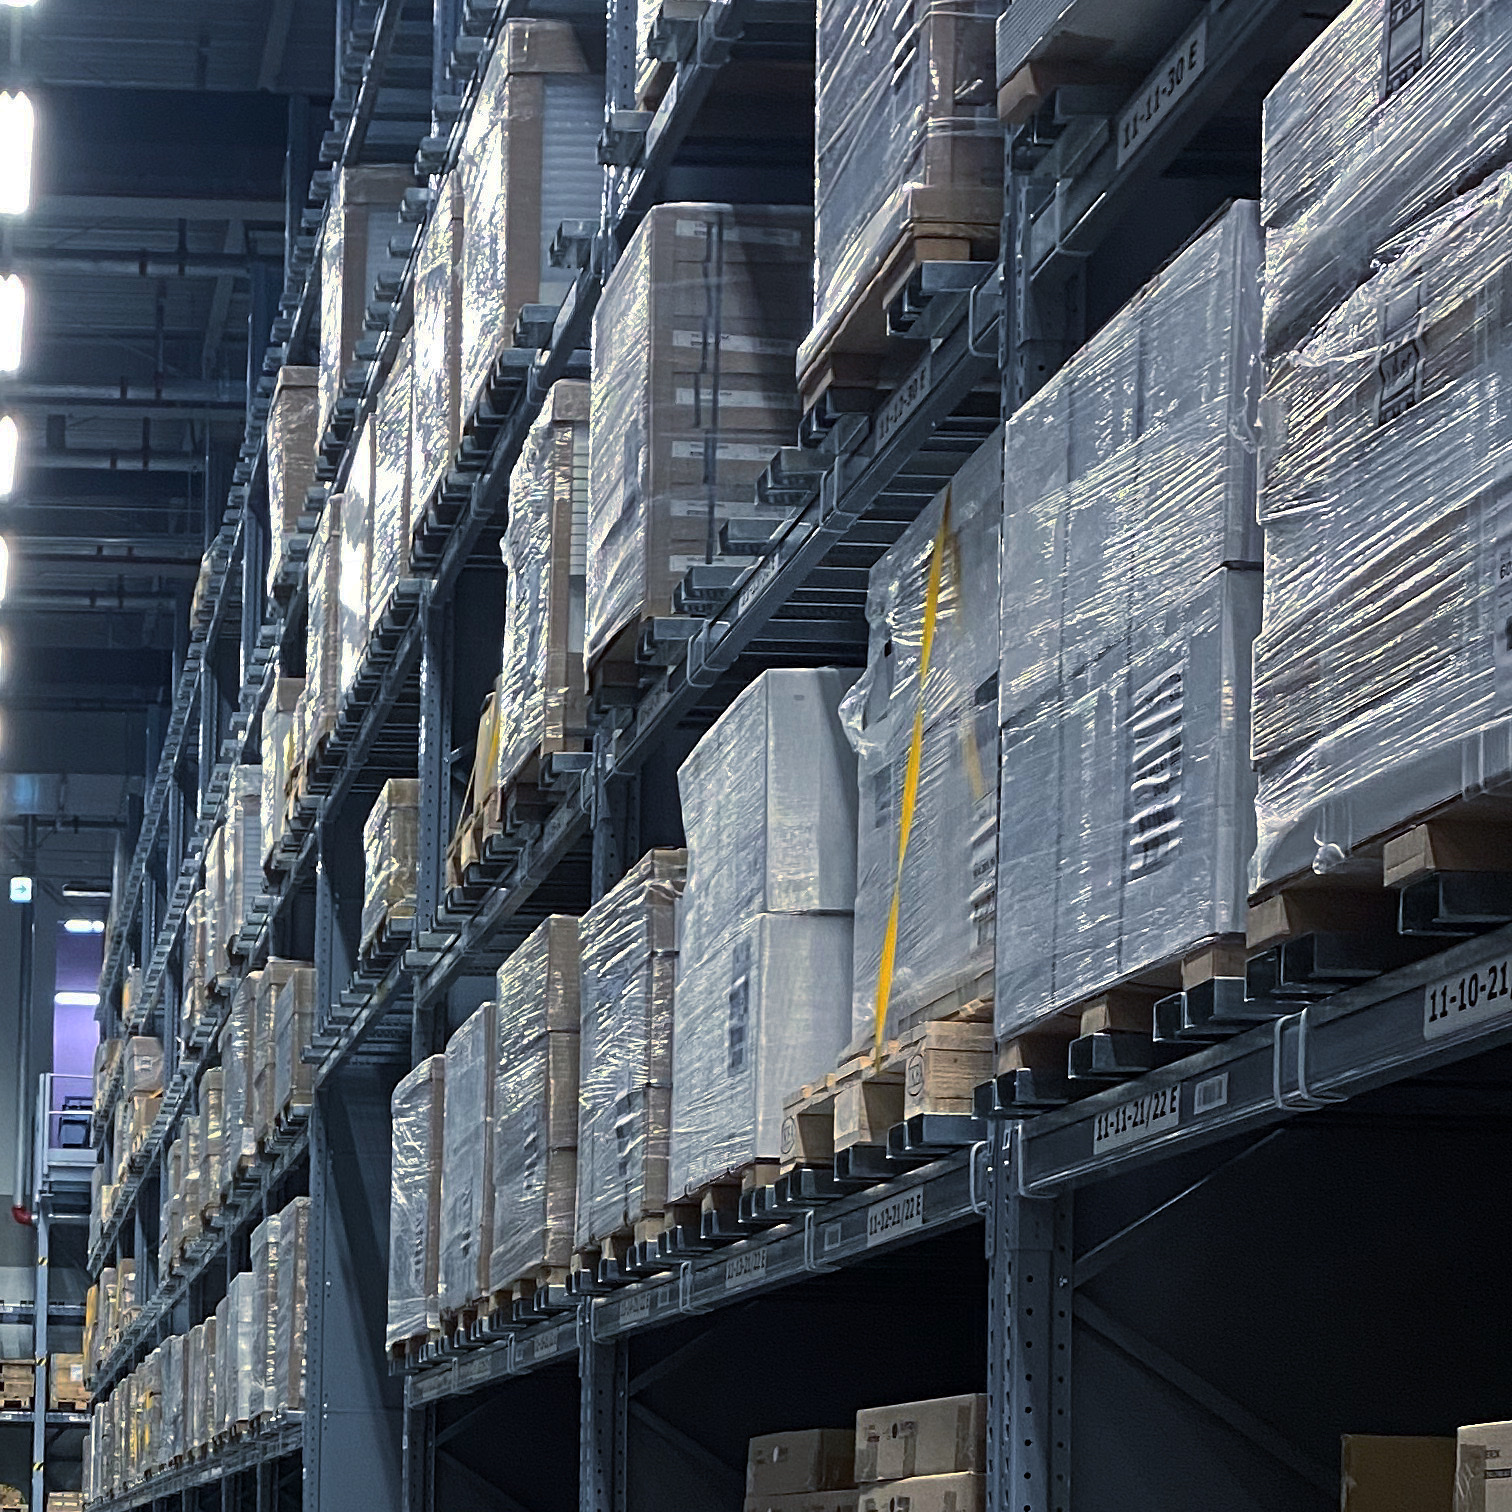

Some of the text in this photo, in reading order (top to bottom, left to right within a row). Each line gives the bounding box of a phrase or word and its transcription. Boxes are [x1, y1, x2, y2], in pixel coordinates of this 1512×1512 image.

[1124, 40, 1198, 149] 11-11-30 E
[1428, 960, 1512, 1023] 11-10-21
[1096, 1085, 1178, 1142] 11-11-21/22 E
[916, 1193, 921, 1217] E
